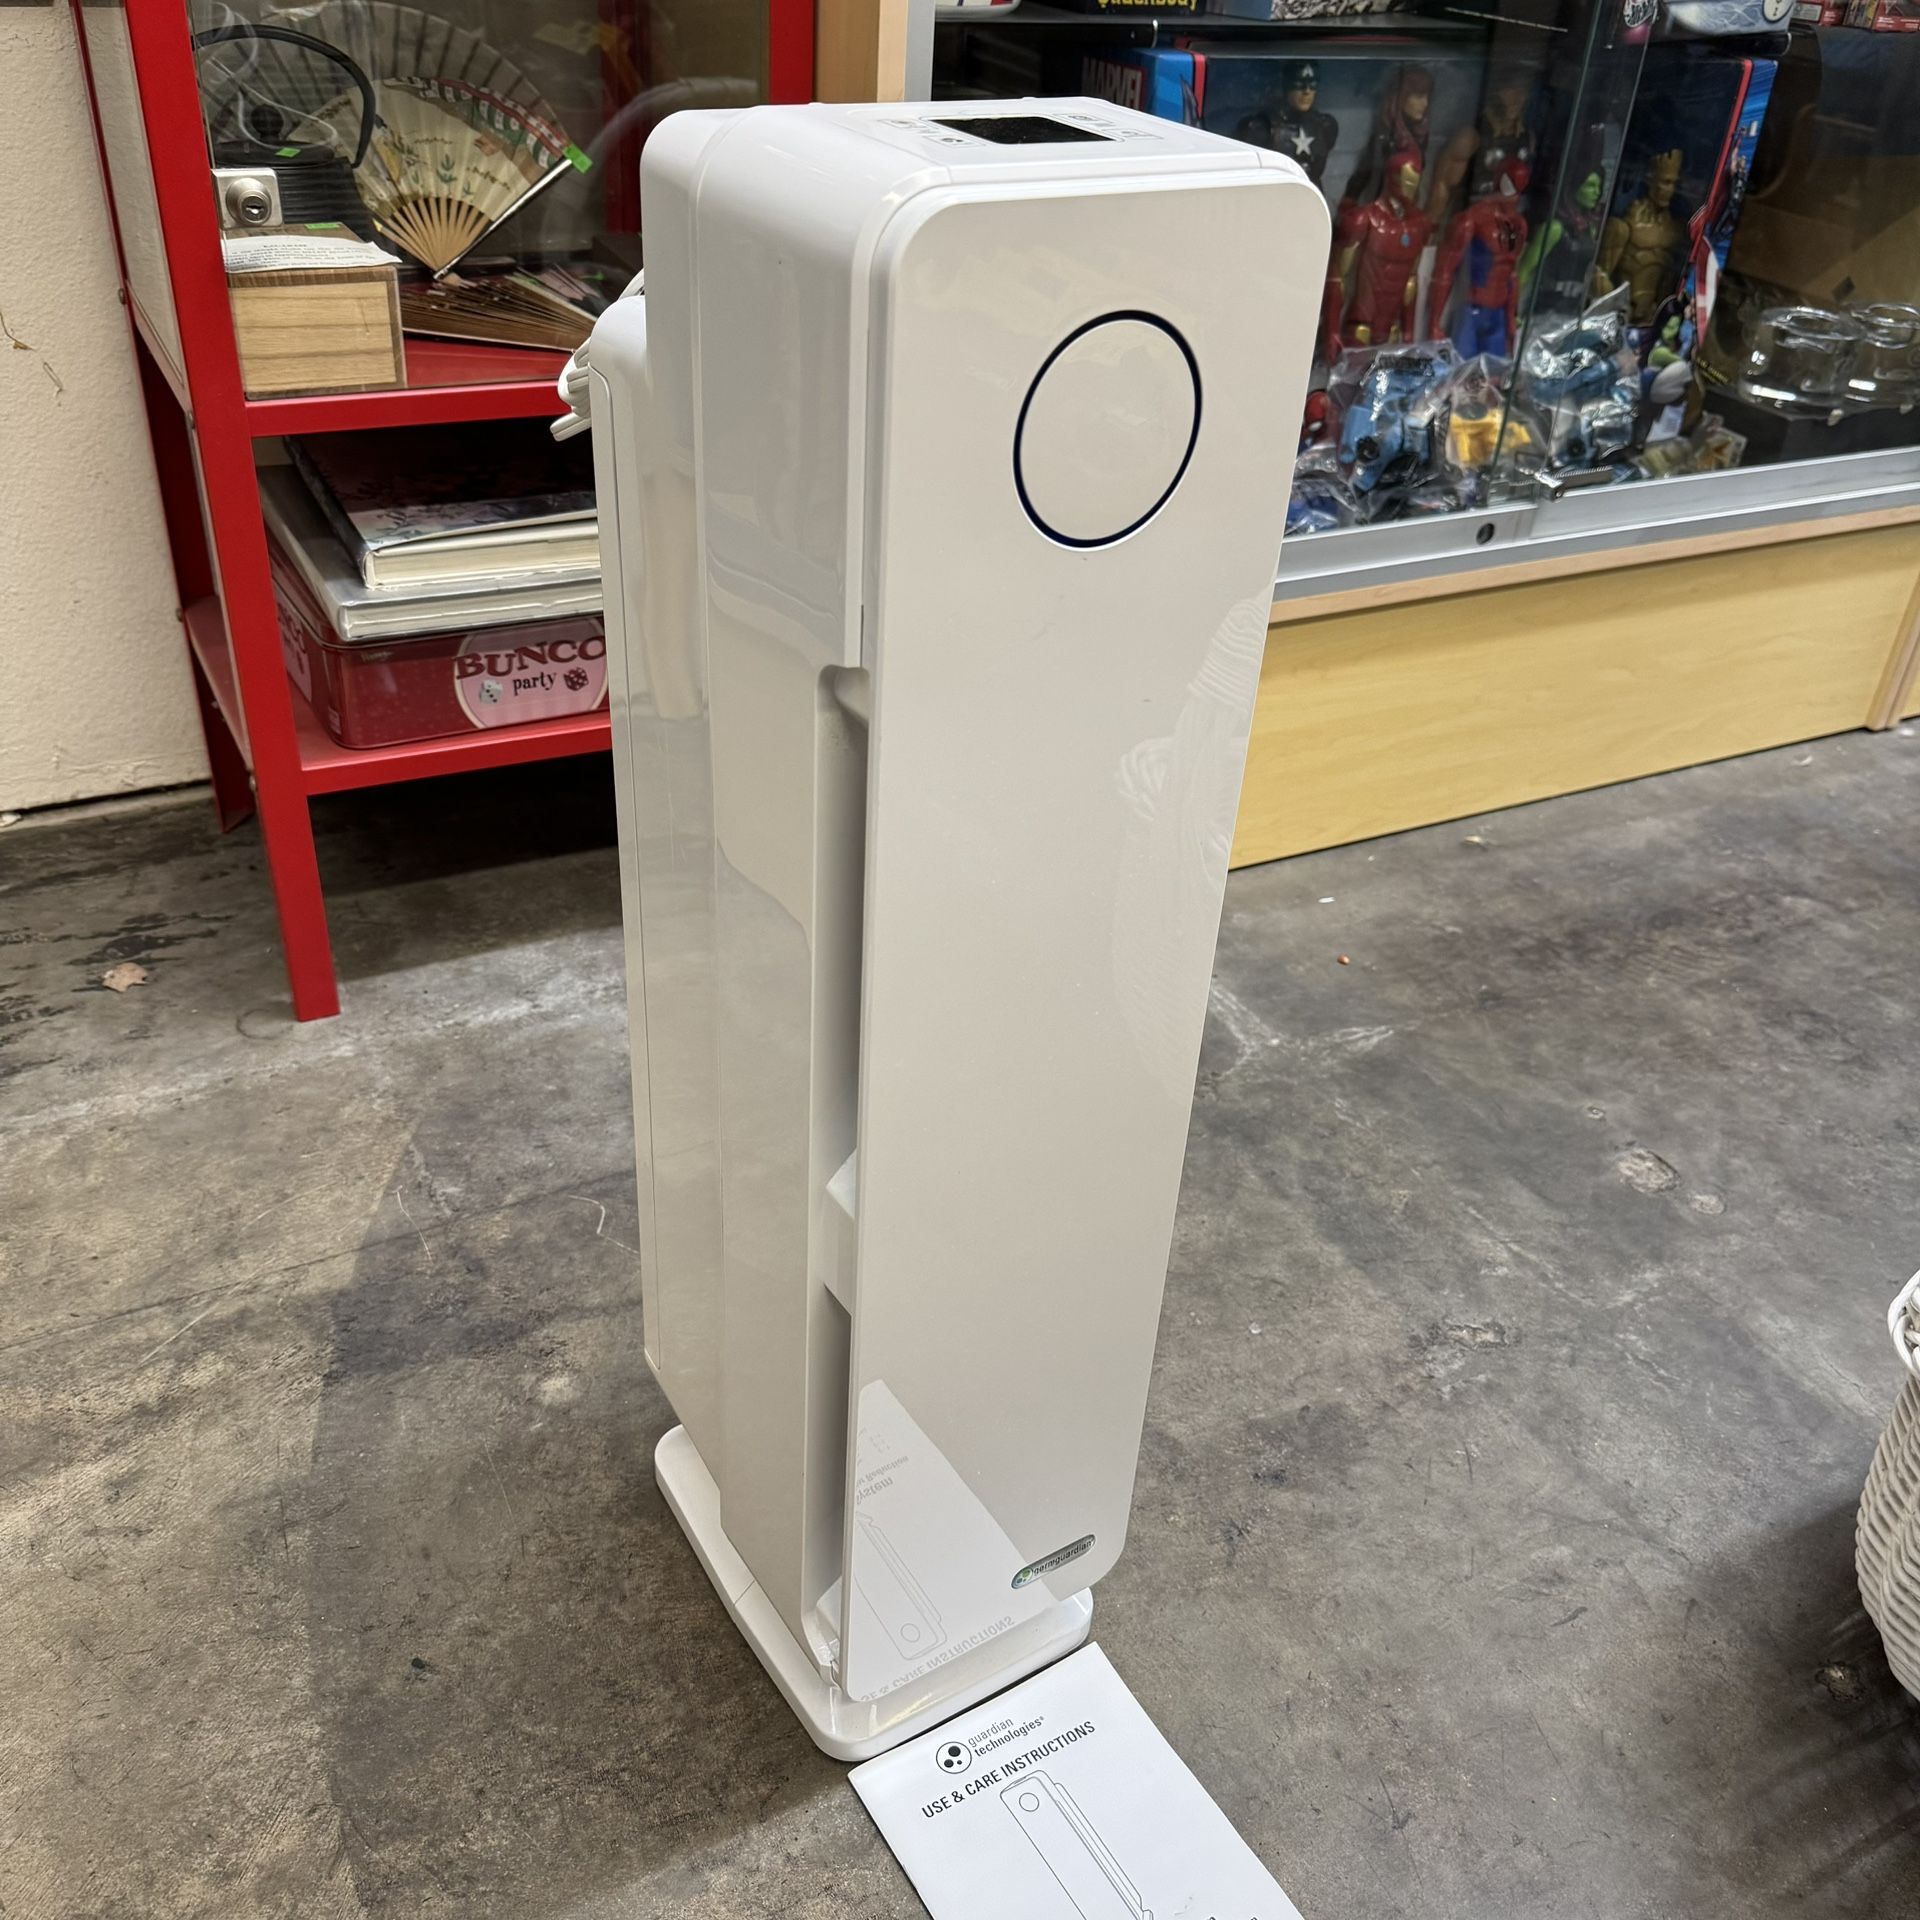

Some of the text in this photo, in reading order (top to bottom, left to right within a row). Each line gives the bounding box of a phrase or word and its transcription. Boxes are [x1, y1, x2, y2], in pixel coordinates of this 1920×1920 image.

[452, 635, 606, 680] BUNCO
[512, 672, 557, 696] party
[968, 1718, 1014, 1748] guardian
[921, 1721, 1096, 1819] USE & CARE INSTRUCTIONS
